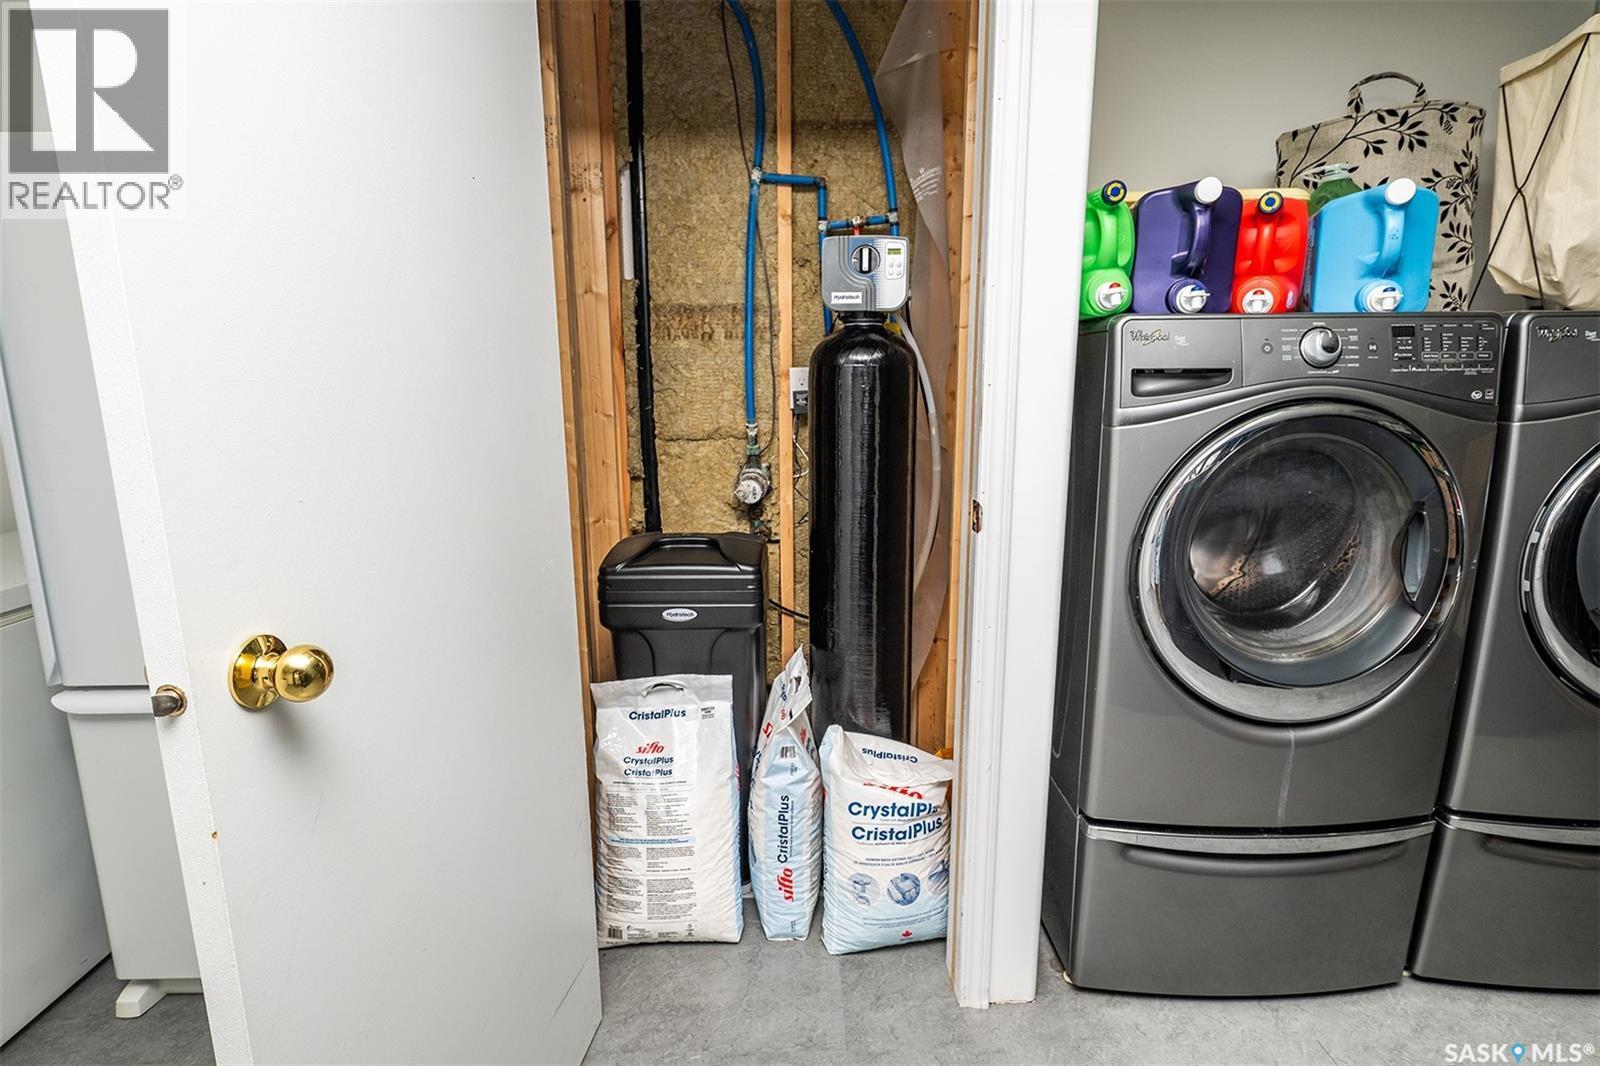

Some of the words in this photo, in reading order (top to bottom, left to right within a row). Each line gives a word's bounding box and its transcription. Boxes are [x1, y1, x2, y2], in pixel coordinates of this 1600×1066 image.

[833, 293, 860, 302] Hydrotech
[1129, 328, 1170, 347] Whirlpool
[628, 708, 687, 721] CristalPlus
[623, 756, 673, 766] CrystalPlus
[861, 747, 919, 764] CristalPlus
[623, 767, 673, 778] CristalPlus
[848, 801, 938, 820] CrystalPl
[777, 794, 790, 864] CristalPlus
[851, 817, 943, 842] CristalPlus
